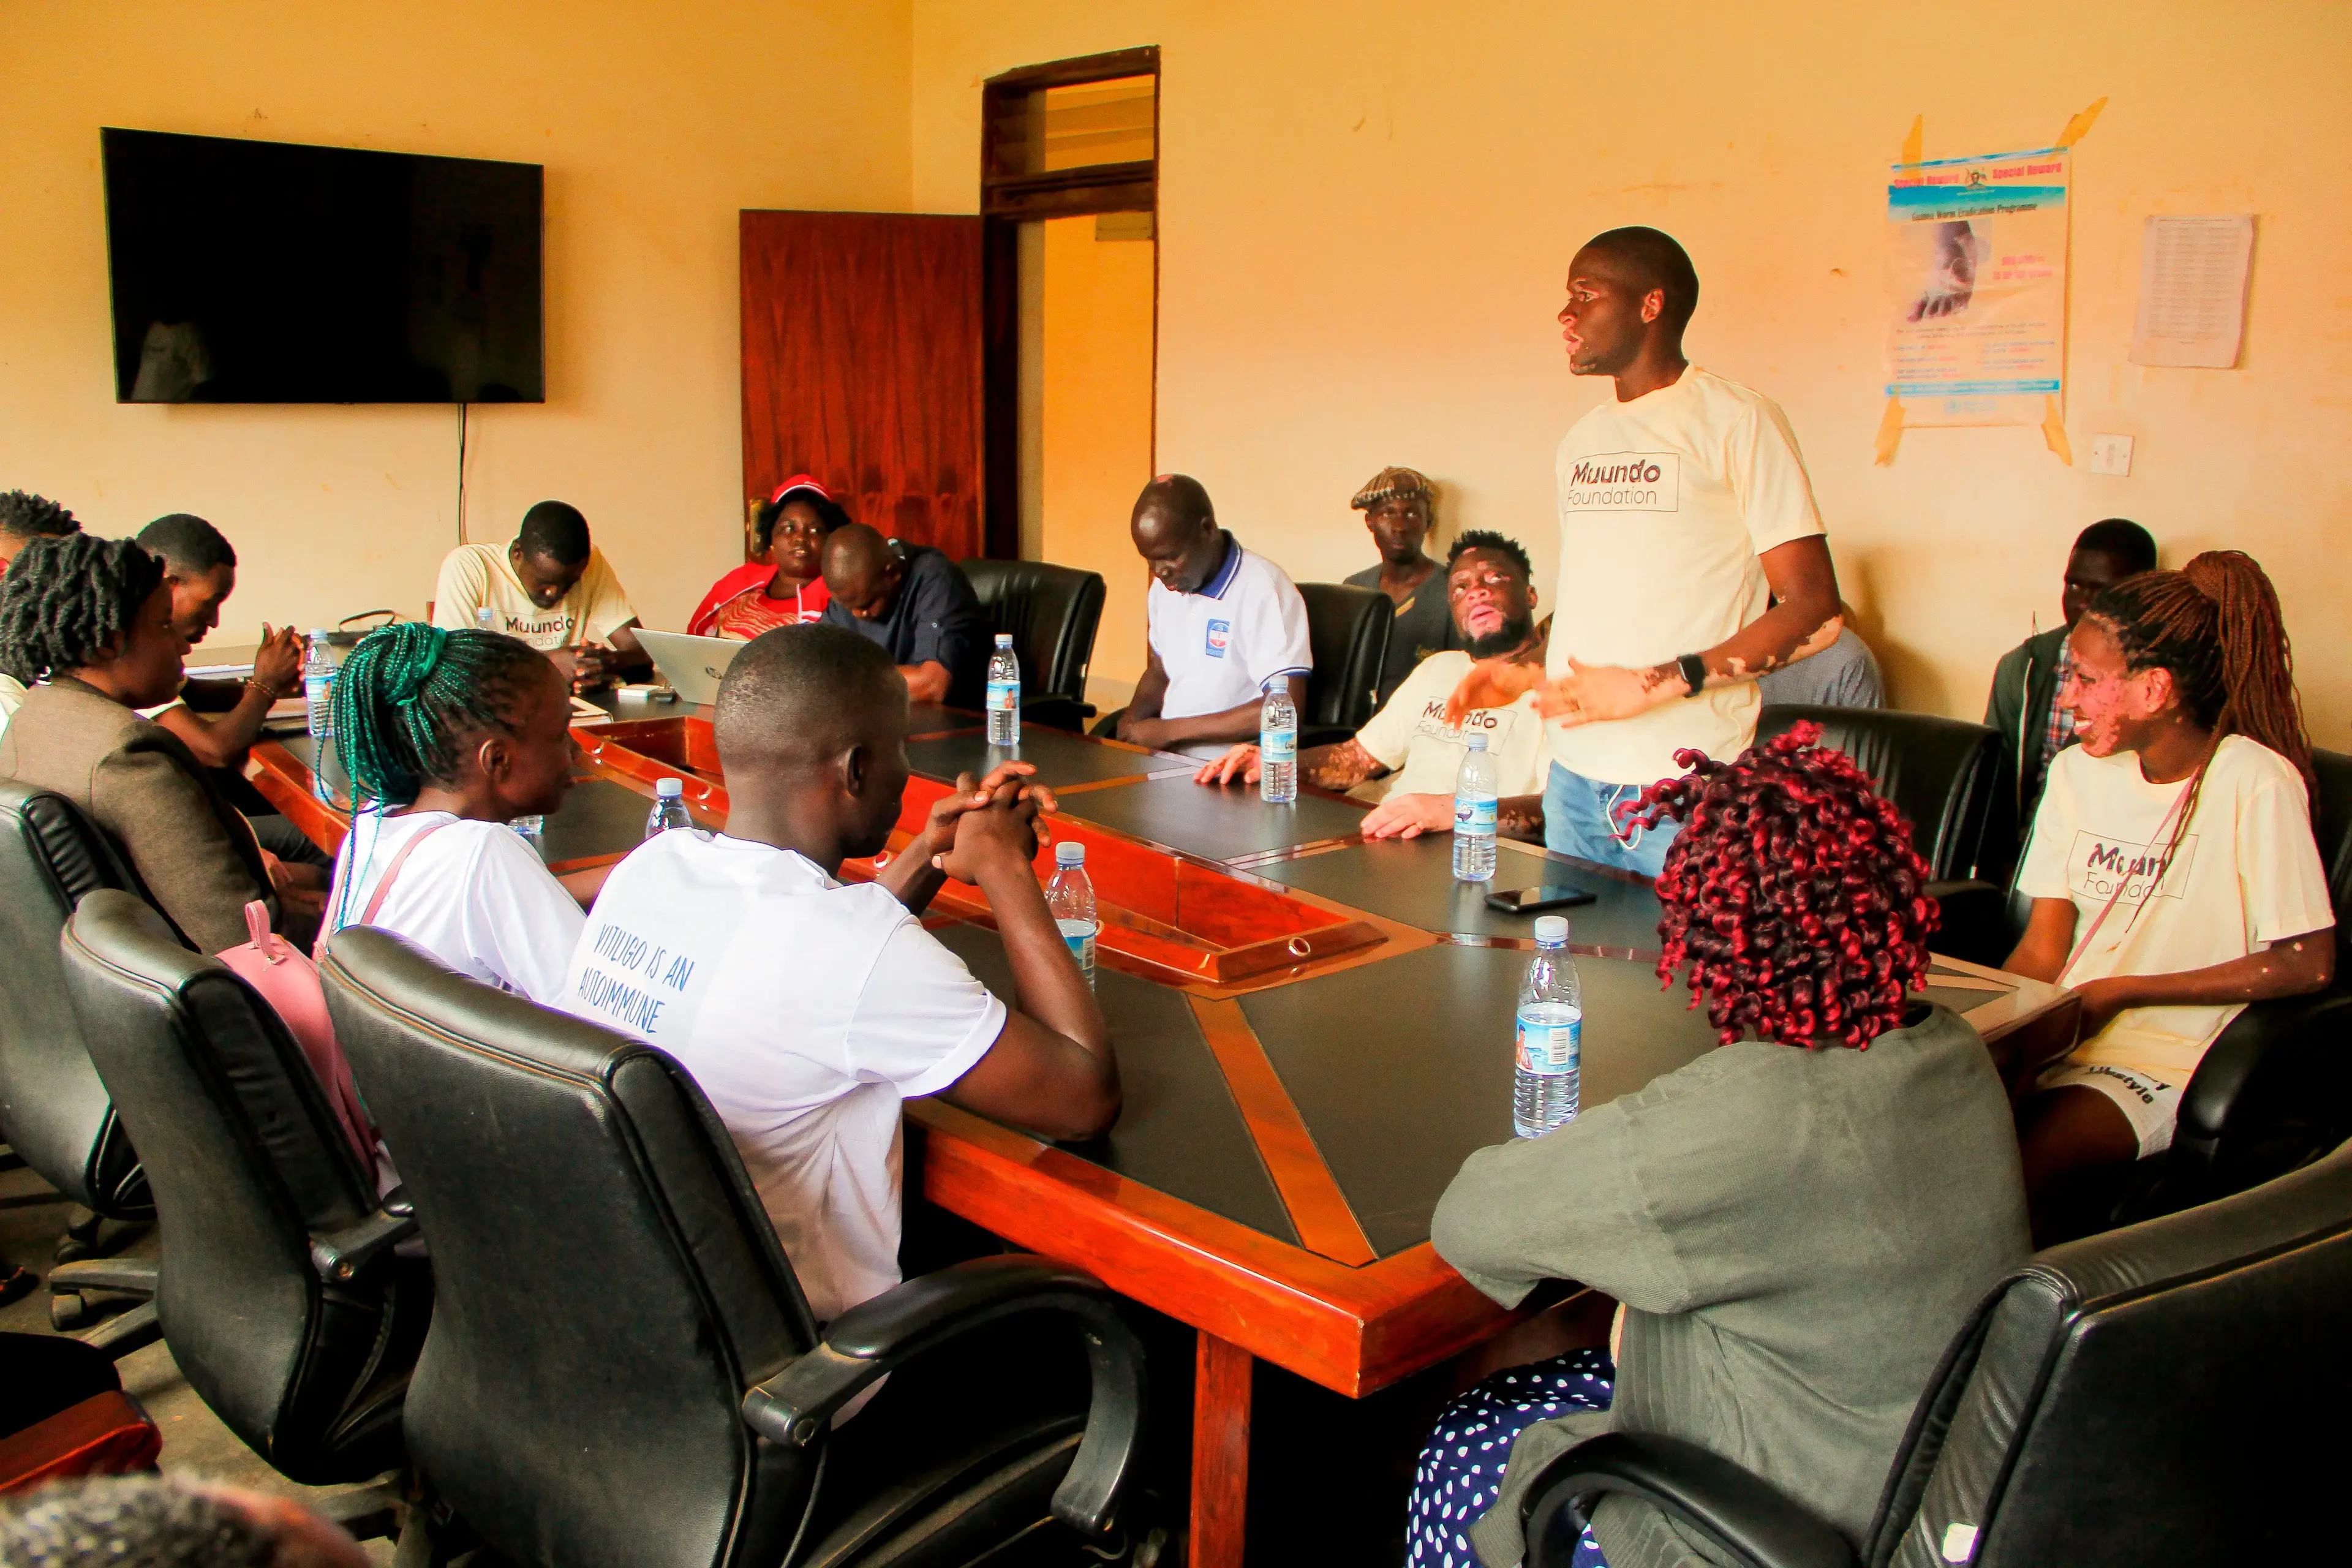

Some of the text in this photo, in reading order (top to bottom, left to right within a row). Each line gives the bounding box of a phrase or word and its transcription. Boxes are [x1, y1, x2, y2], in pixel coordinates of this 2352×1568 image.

[1570, 459, 1661, 487] Muundo
[1567, 486, 1657, 507] Foundation
[1422, 701, 1498, 729] Mundo
[2087, 842, 2161, 876] Muun
[594, 924, 695, 992] VITILIGO IS AN
[578, 966, 666, 1033] AUTOIMMUNE
